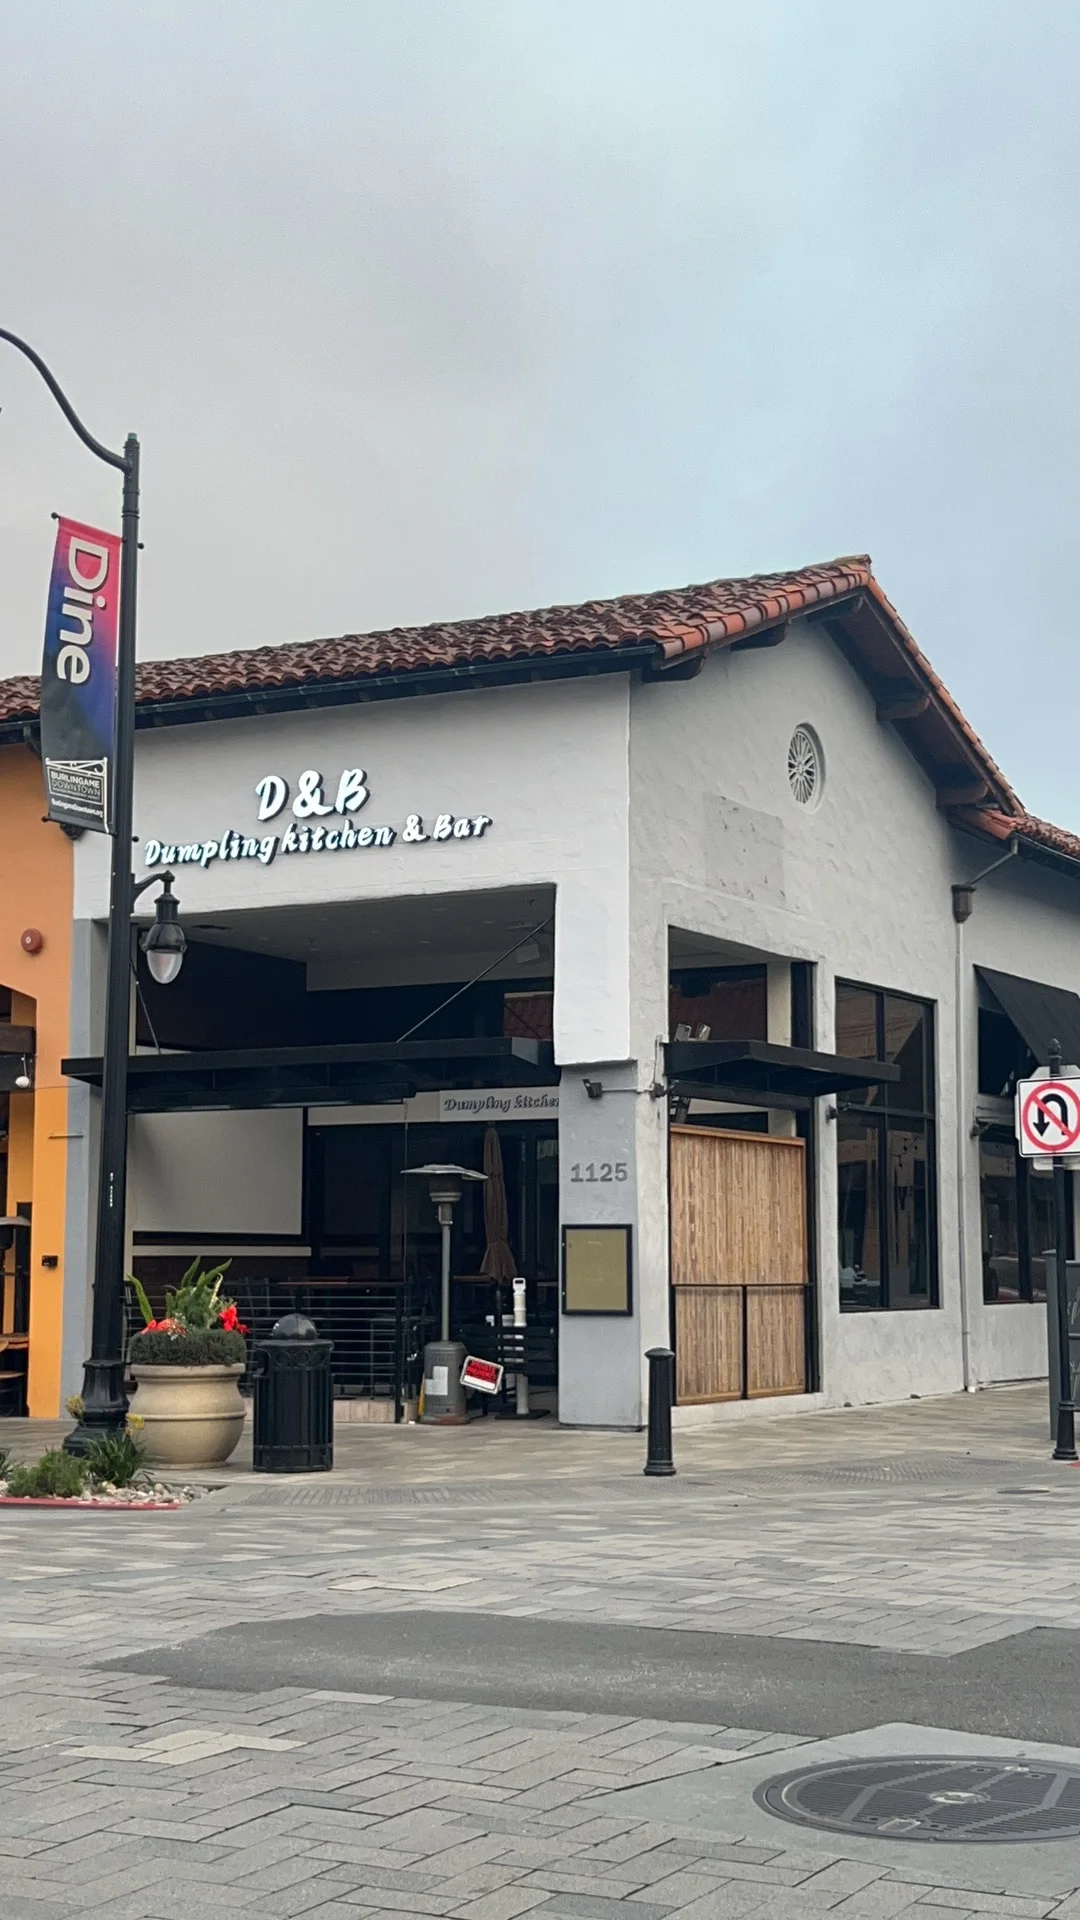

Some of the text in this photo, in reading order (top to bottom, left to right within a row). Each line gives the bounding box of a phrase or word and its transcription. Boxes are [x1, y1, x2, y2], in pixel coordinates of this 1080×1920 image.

[57, 536, 109, 684] Dine
[50, 770, 100, 789] BURLINGAME
[51, 779, 101, 796] DOWNTOWN
[144, 813, 493, 869] Dumpling kitchen & Bar
[444, 1096, 511, 1114] Dumpling
[570, 1162, 628, 1182] 1125
